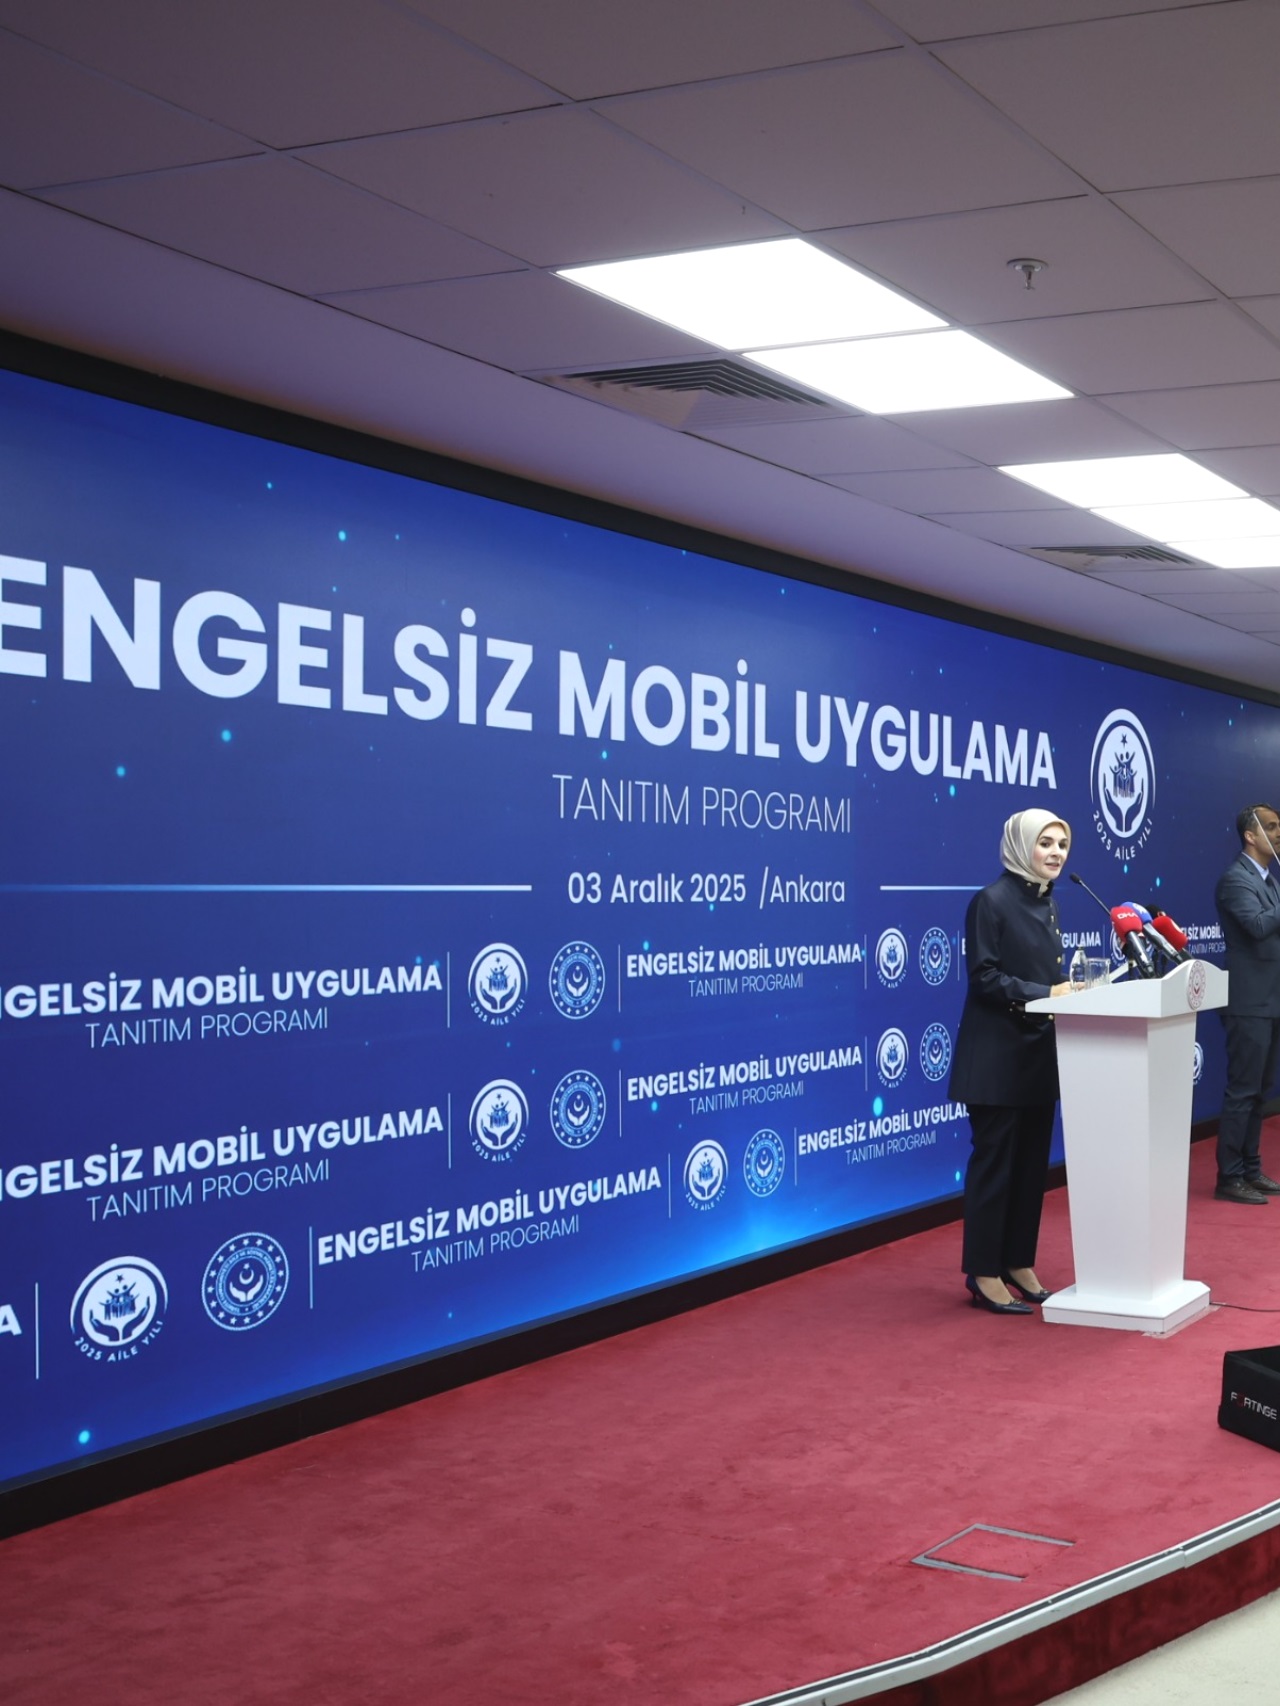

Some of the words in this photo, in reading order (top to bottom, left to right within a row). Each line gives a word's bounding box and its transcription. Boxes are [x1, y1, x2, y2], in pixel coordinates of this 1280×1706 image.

[0, 554, 533, 731] ENGELSİZ
[559, 650, 780, 758] MOBİL
[796, 691, 1057, 789] UYGULAMA
[552, 774, 690, 825] TANITIM
[703, 787, 850, 833] PROGRAMI
[1093, 810, 1112, 851] 2025
[1114, 845, 1136, 860] AİLE
[1138, 818, 1153, 849] YILI
[568, 872, 601, 903] 03
[610, 873, 683, 903] Aralık
[691, 874, 746, 903] 2025
[760, 866, 845, 909] /Ankara
[627, 945, 714, 977] ENGELSİZ
[719, 943, 771, 971] MOBİL
[775, 943, 860, 967] UYGULAMA
[1060, 932, 1101, 948] GULAMA
[0, 972, 141, 1018] GELSİZ
[152, 967, 264, 1008] MOBİL
[272, 965, 442, 1000] UYGULAMA
[688, 978, 737, 997] TANITIM
[742, 973, 803, 992] PROGRAMI
[85, 1017, 190, 1048] TANITIM
[201, 1007, 327, 1039] PROGRAMI
[471, 1001, 487, 1022] 2025
[628, 1063, 715, 1101] ENGELSİZ
[720, 1054, 772, 1086] MOBİL
[776, 1046, 862, 1077] UYGULAMA
[689, 1091, 738, 1115] TANITIM
[742, 1080, 803, 1105] PROGRAMI
[472, 1140, 488, 1159] 2025
[799, 1119, 866, 1155] ENGELSİZ
[869, 1109, 911, 1139] MOBİL
[914, 1102, 969, 1135] UYGULA
[846, 1143, 884, 1164] TANITIM
[887, 1130, 936, 1155] PROGRAMI
[0, 1143, 143, 1201] GELSİZ
[154, 1125, 265, 1176] MOBİL
[273, 1107, 443, 1156] UYGULAMA
[87, 1182, 192, 1221] TANITIM
[203, 1159, 328, 1201] PROGRAMI
[318, 1207, 450, 1265] ENGELSİZ
[457, 1189, 534, 1233] MOBİL
[539, 1167, 661, 1214] UYGULAMA
[411, 1237, 483, 1272] TANITIM
[491, 1215, 578, 1253] PROGRAMI
[74, 1337, 102, 1360] 2025
[107, 1345, 138, 1362] AİLE
[141, 1320, 163, 1345] YILI
[1231, 1392, 1277, 1420] FORTINGE
